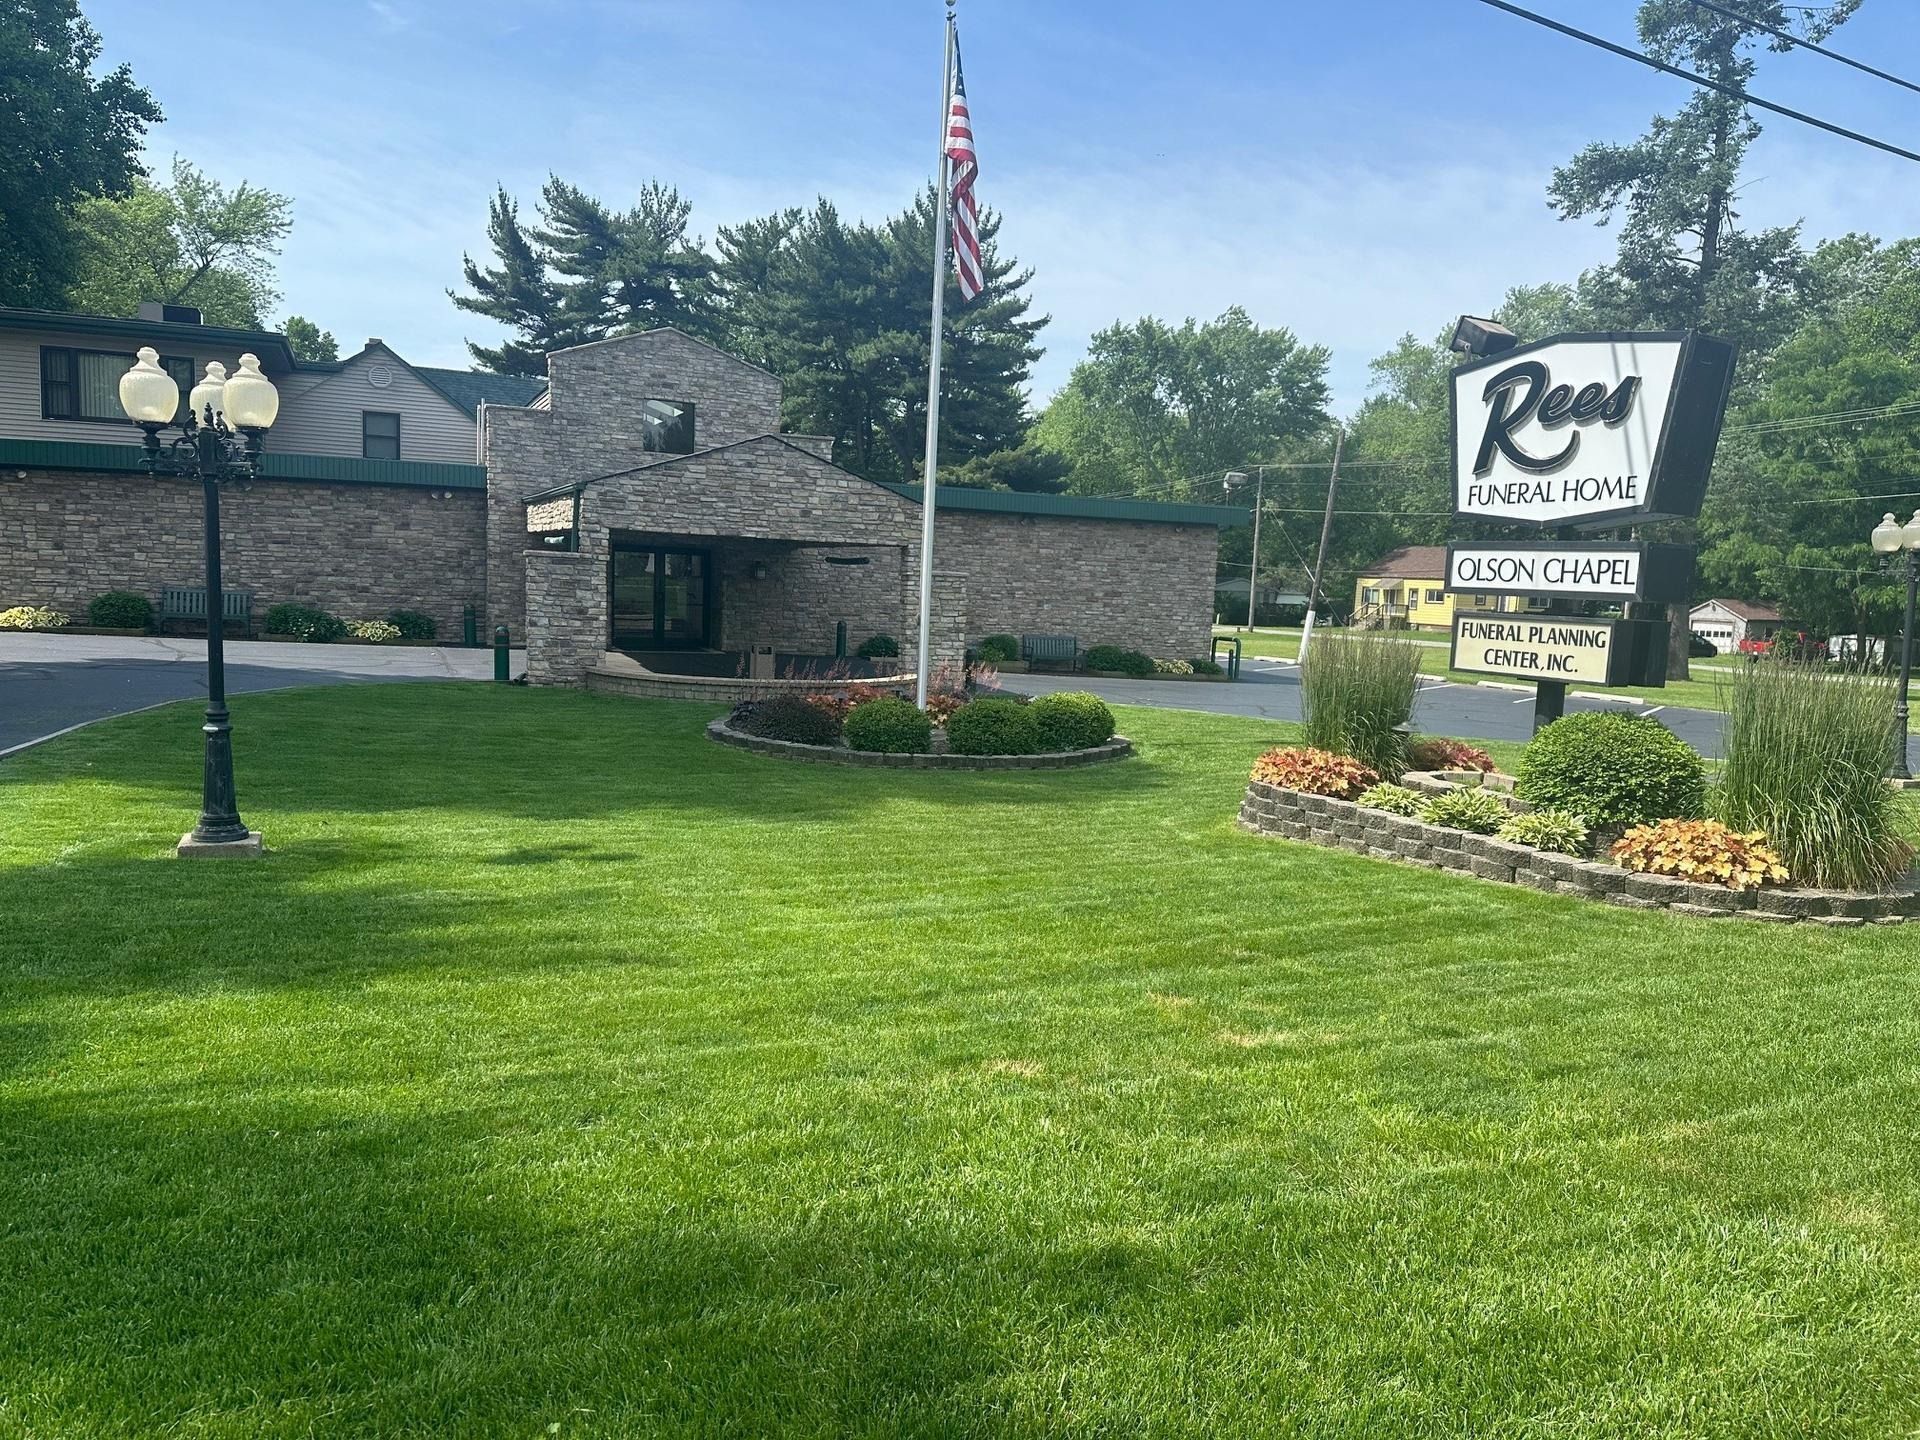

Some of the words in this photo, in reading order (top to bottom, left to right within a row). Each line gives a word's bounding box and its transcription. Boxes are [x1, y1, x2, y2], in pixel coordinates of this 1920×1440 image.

[1472, 361, 1642, 480] Rees
[1467, 481, 1555, 506] FUNERAL
[1562, 475, 1638, 502] HOME
[1457, 557, 1535, 583] OLSON
[1543, 558, 1636, 586] CHAPEL
[1461, 622, 1524, 642] FUNERAL
[1528, 626, 1607, 649] PLANNING
[1484, 648, 1545, 672] CENTER,
[1546, 653, 1578, 673] INC.
